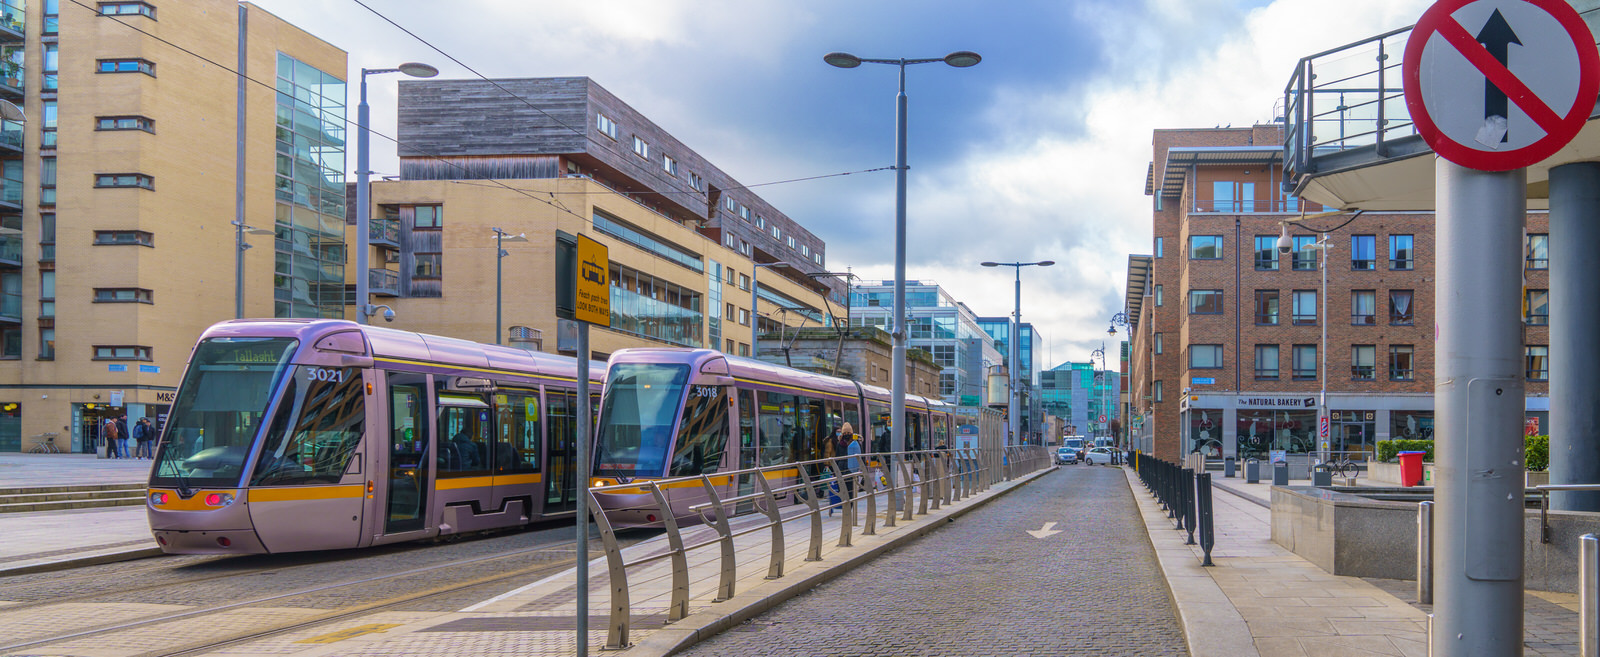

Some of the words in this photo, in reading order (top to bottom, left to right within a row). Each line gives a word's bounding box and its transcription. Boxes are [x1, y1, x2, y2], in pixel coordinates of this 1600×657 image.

[577, 301, 588, 311] LOOK
[588, 303, 599, 313] BOTH
[599, 307, 609, 317] WAYS
[234, 350, 277, 362] Tallaght
[306, 367, 343, 383] 3021
[696, 386, 718, 398] 3018
[1248, 398, 1276, 406] NATURAL
[1277, 398, 1302, 406] BAKERY
